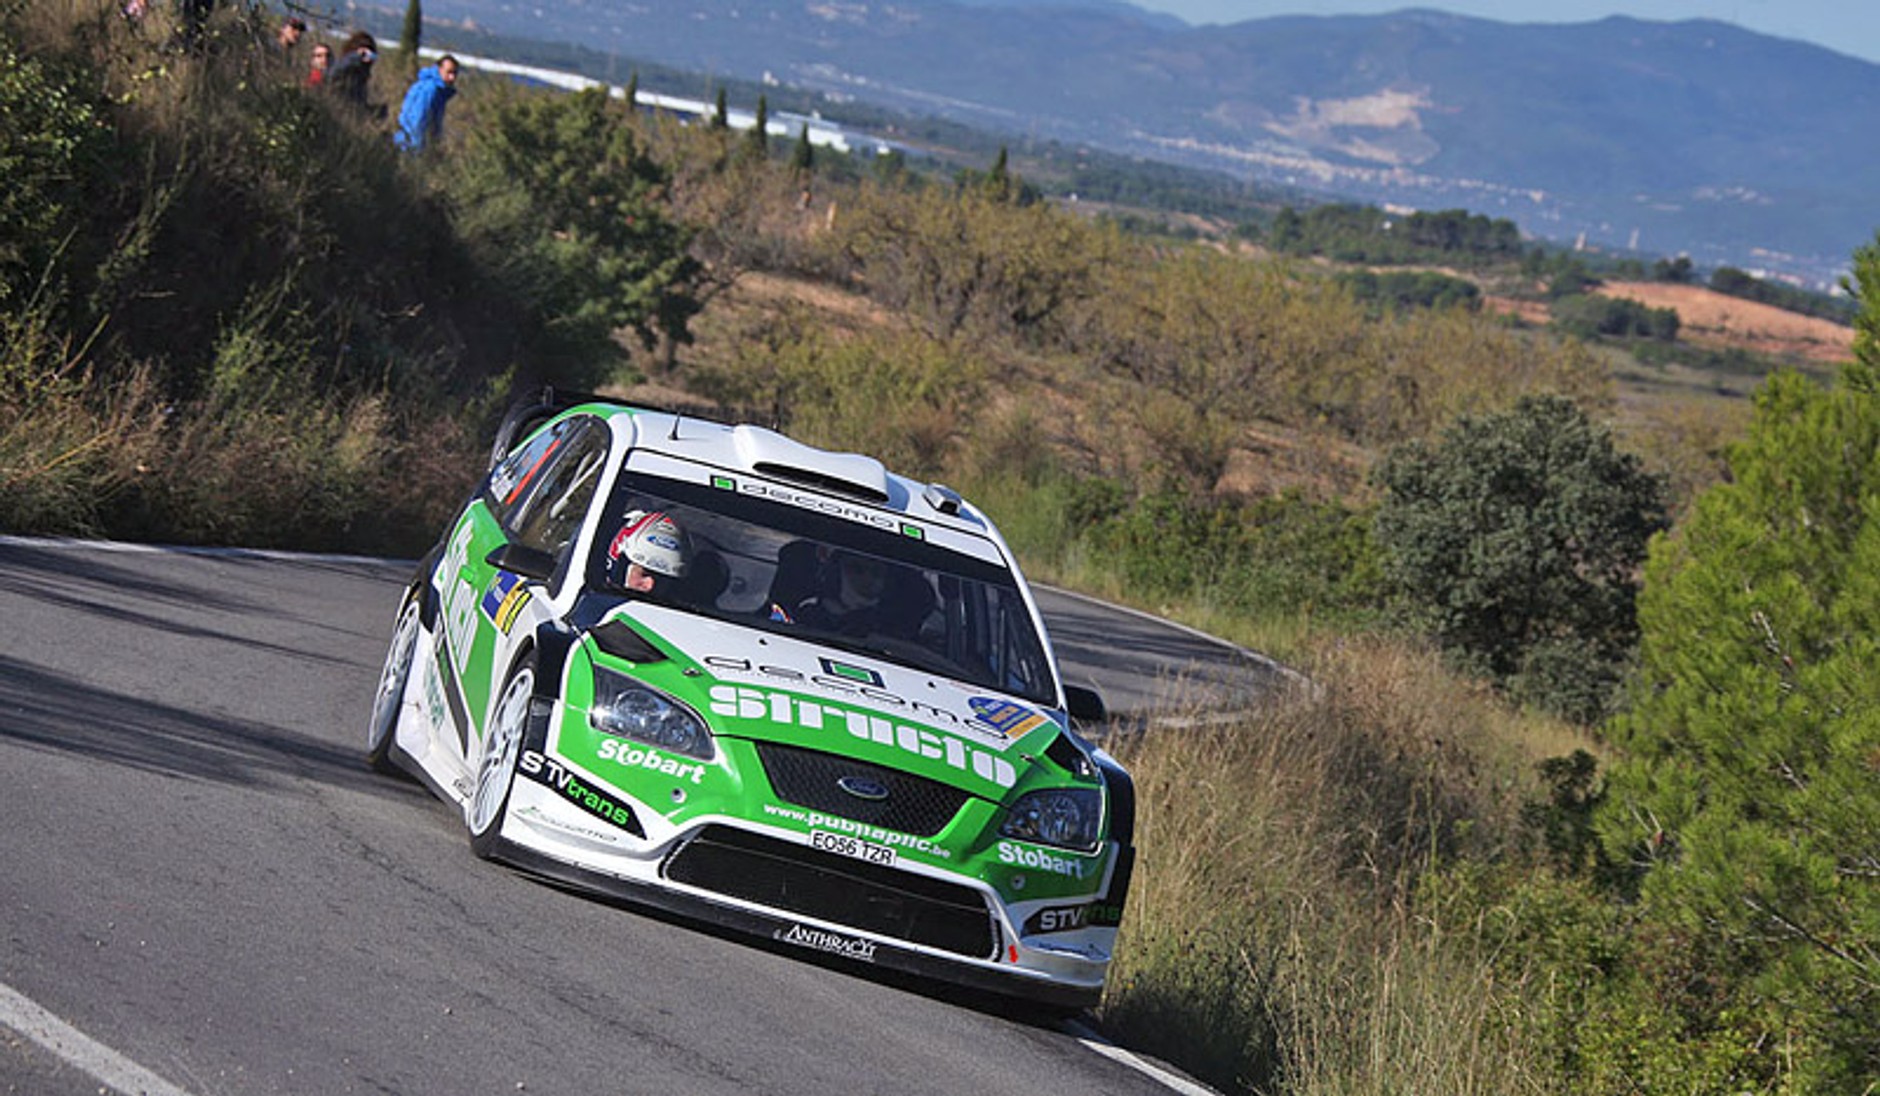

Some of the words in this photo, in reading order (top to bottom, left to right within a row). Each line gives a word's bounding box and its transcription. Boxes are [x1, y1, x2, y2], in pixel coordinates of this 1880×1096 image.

[742, 482, 894, 529] decomo
[708, 684, 1017, 788] Structo
[597, 738, 706, 784] Stobart
[862, 843, 893, 866] TZR
[998, 841, 1083, 879] Stobart
